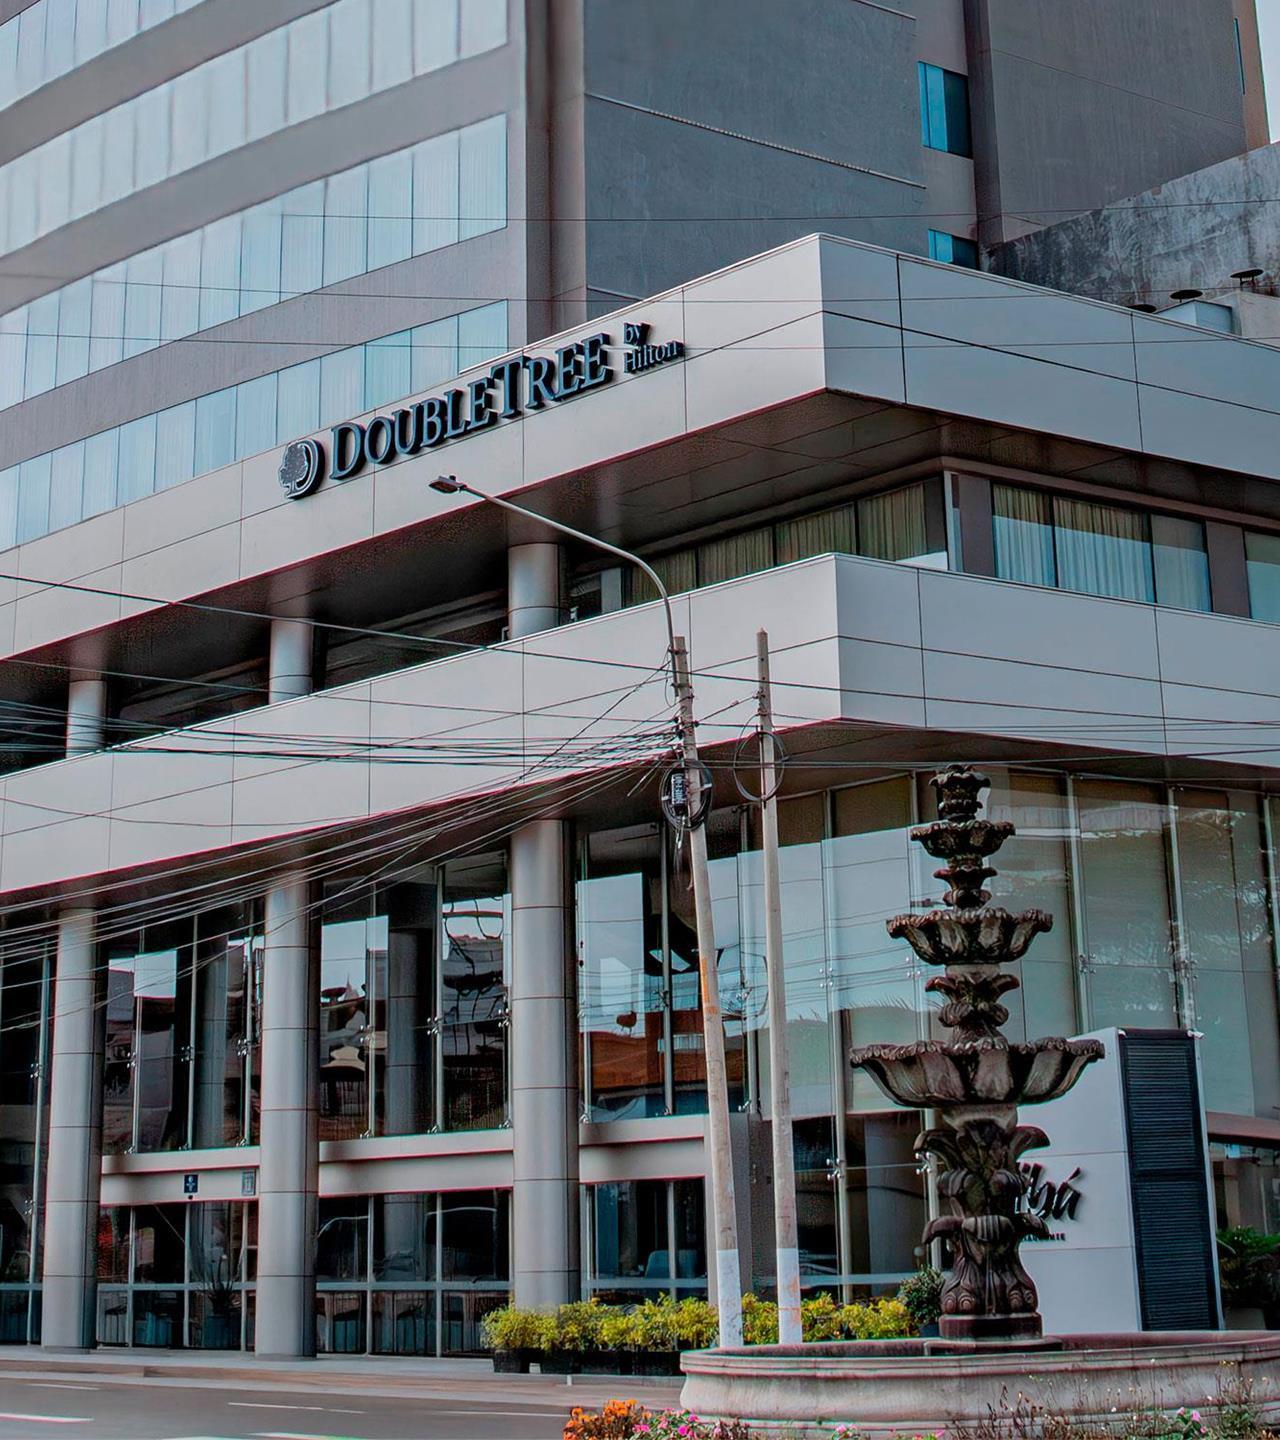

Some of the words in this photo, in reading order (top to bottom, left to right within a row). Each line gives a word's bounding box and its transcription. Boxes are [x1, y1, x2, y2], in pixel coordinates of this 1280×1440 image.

[624, 322, 650, 346] by
[624, 340, 685, 373] Hilton
[329, 333, 613, 480] DOUBLETREE
